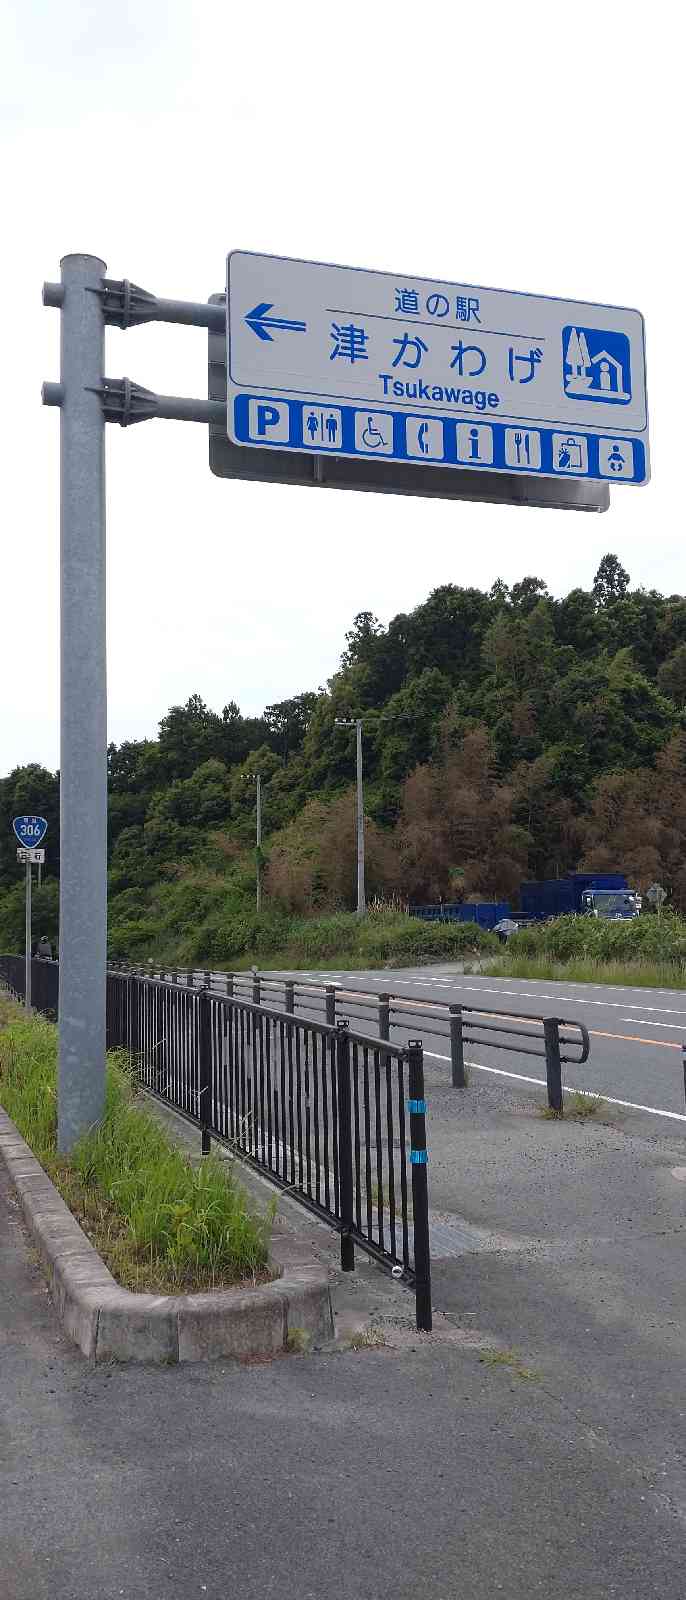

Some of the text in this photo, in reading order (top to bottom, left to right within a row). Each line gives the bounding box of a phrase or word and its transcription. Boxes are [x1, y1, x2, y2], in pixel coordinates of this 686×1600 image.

[394, 287, 482, 324] 道の駅
[329, 324, 544, 384] 津かわげ
[378, 374, 500, 410] Tsukawage
[256, 407, 280, 436] P
[20, 824, 41, 836] 306
